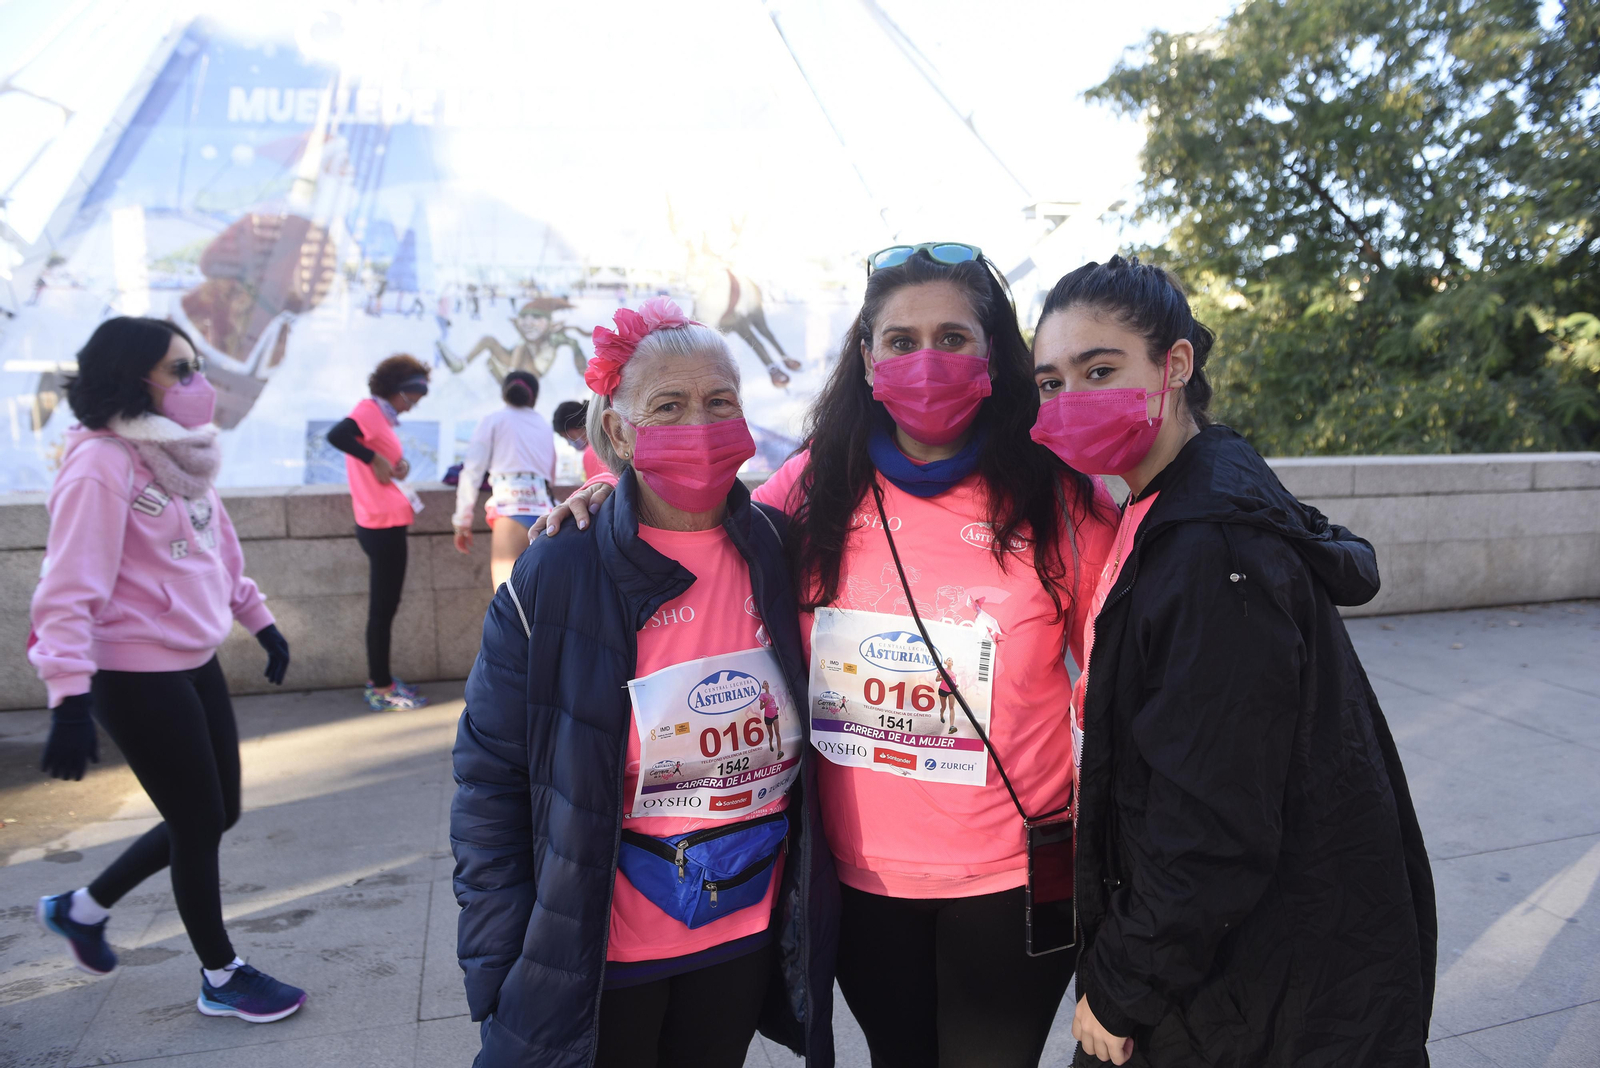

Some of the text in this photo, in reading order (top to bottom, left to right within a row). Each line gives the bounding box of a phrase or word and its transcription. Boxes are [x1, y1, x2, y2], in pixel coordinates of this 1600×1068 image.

[852, 513, 902, 532] YSHO
[695, 685, 757, 708] ASTURIANA
[864, 678, 936, 712] 016
[878, 715, 913, 731] 1541
[700, 717, 764, 758] 016
[843, 722, 955, 747] CARRERA DE LA MUJER
[817, 741, 867, 757] OYSHO
[717, 757, 749, 775] 1542
[886, 753, 912, 764] Santander
[941, 762, 974, 771] ZURICH
[676, 764, 782, 789] CARRERA DE LA MUJER
[768, 777, 789, 793] ZURICH
[643, 796, 701, 808] OYSHO
[722, 797, 747, 807] Santander
